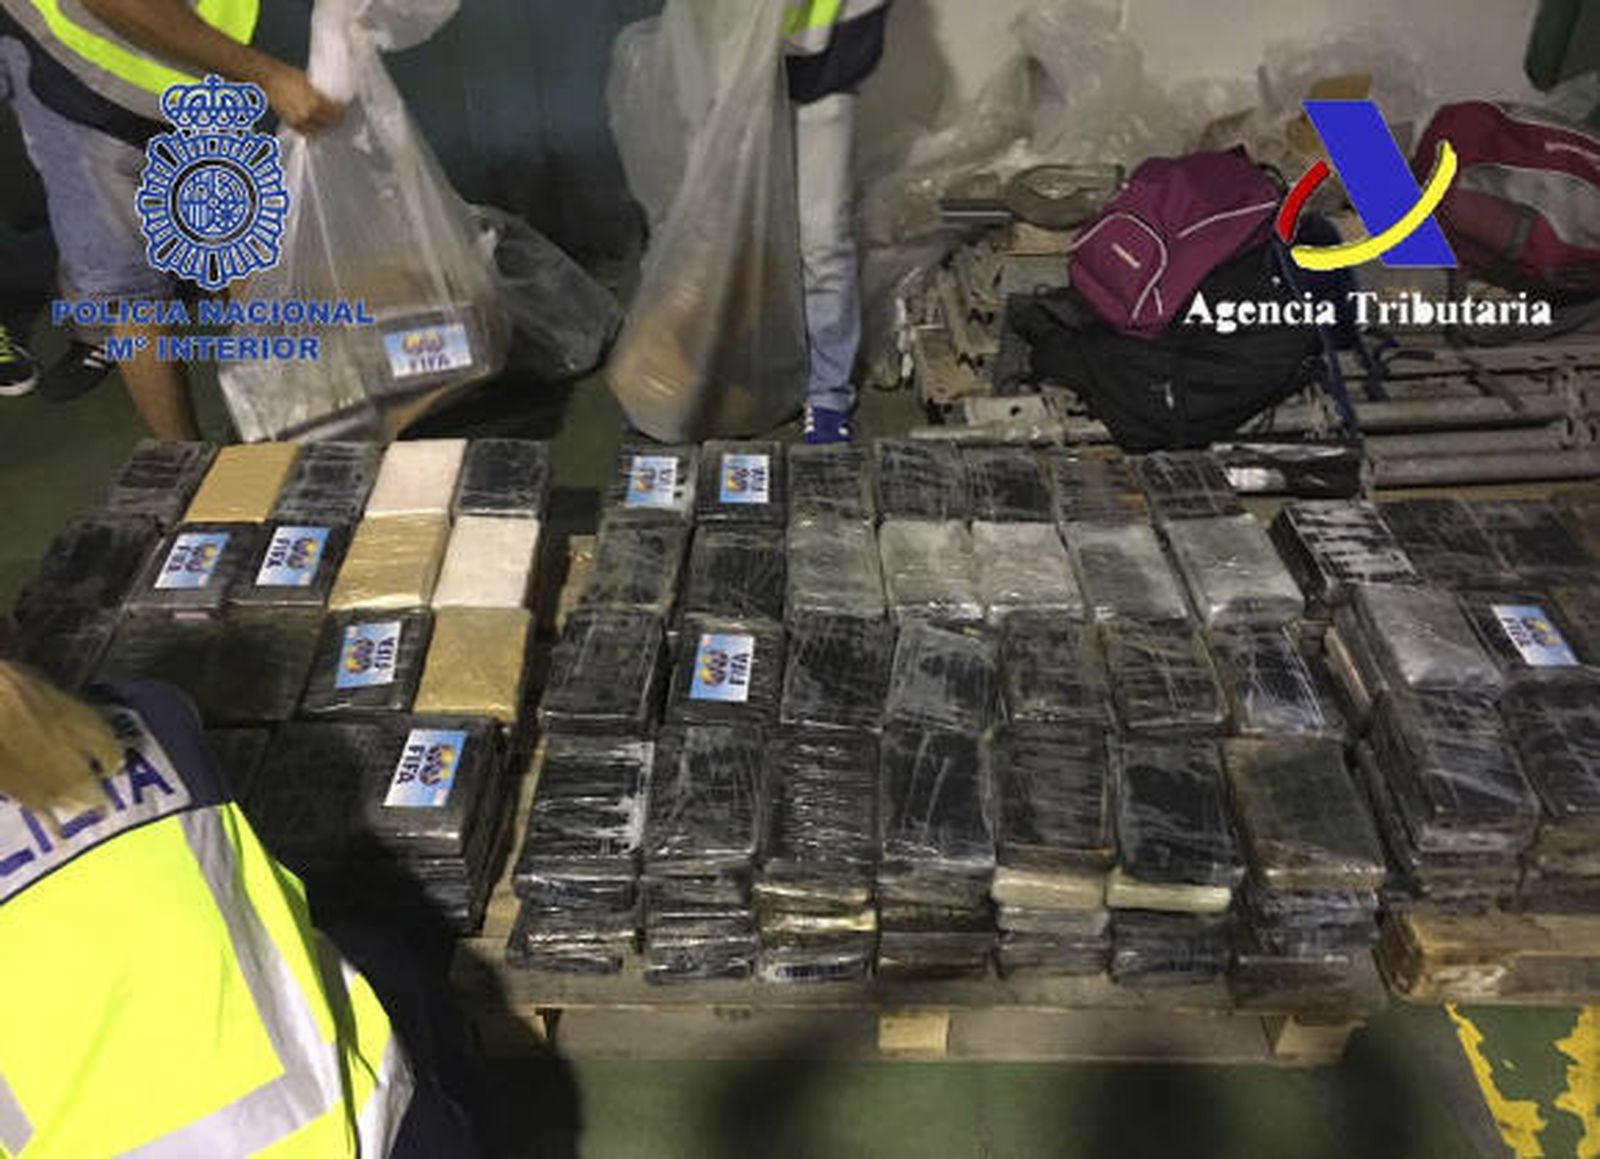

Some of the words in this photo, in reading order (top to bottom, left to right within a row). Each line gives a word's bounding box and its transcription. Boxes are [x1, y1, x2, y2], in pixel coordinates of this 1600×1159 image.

[266, 537, 290, 569] FIFA
[729, 651, 750, 686] FIFA
[395, 744, 426, 786] FIFA
